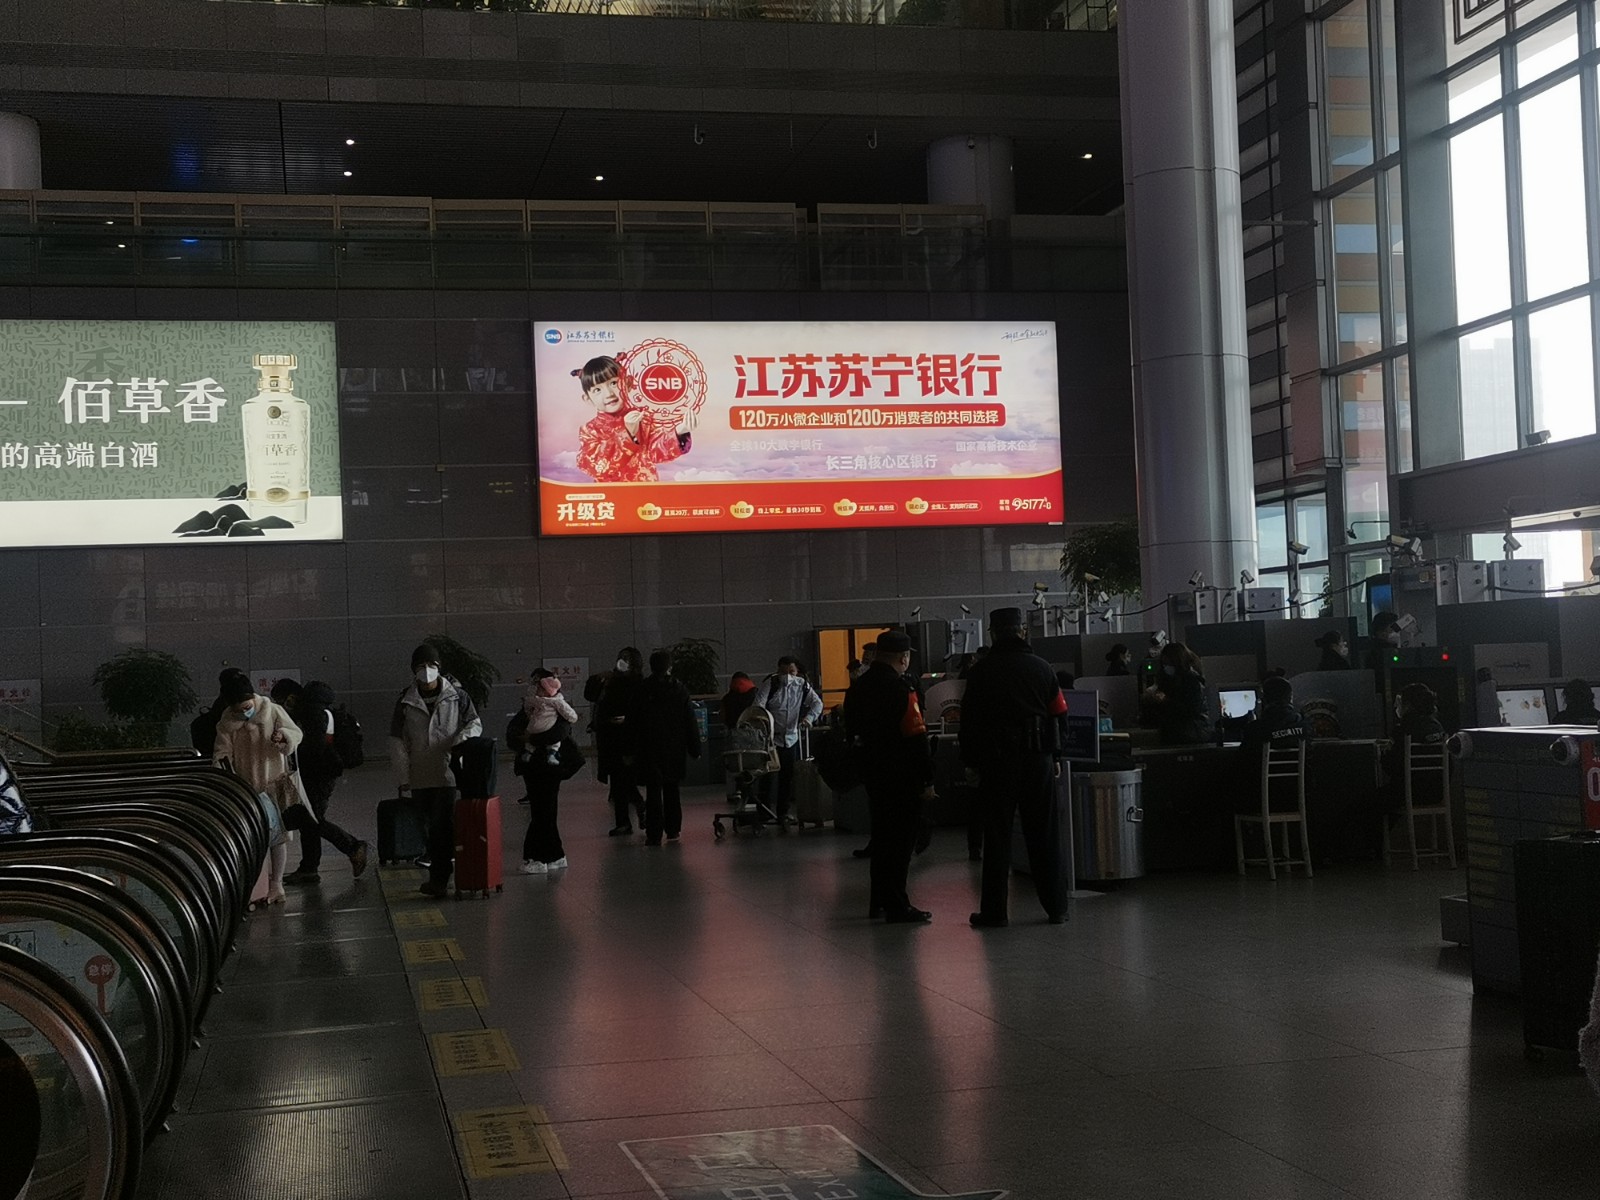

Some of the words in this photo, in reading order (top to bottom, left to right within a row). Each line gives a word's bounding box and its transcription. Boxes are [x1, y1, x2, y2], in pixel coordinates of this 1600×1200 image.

[566, 330, 616, 340] 江苏苏宁银行
[644, 376, 683, 390] SNB
[733, 352, 1003, 399] 江苏苏宁银行
[57, 375, 228, 424] 佰草香
[738, 407, 999, 428] 120万小微企业和1200万消费者的共同选择
[729, 439, 824, 453] 全球10大数字银行
[955, 440, 1038, 452] 国家高新技术企业
[1, 441, 160, 469] 的高端白酒
[825, 454, 938, 471] 长三角核心区银行
[556, 501, 616, 522] 升级贷
[1271, 727, 1304, 739] SECURITY
